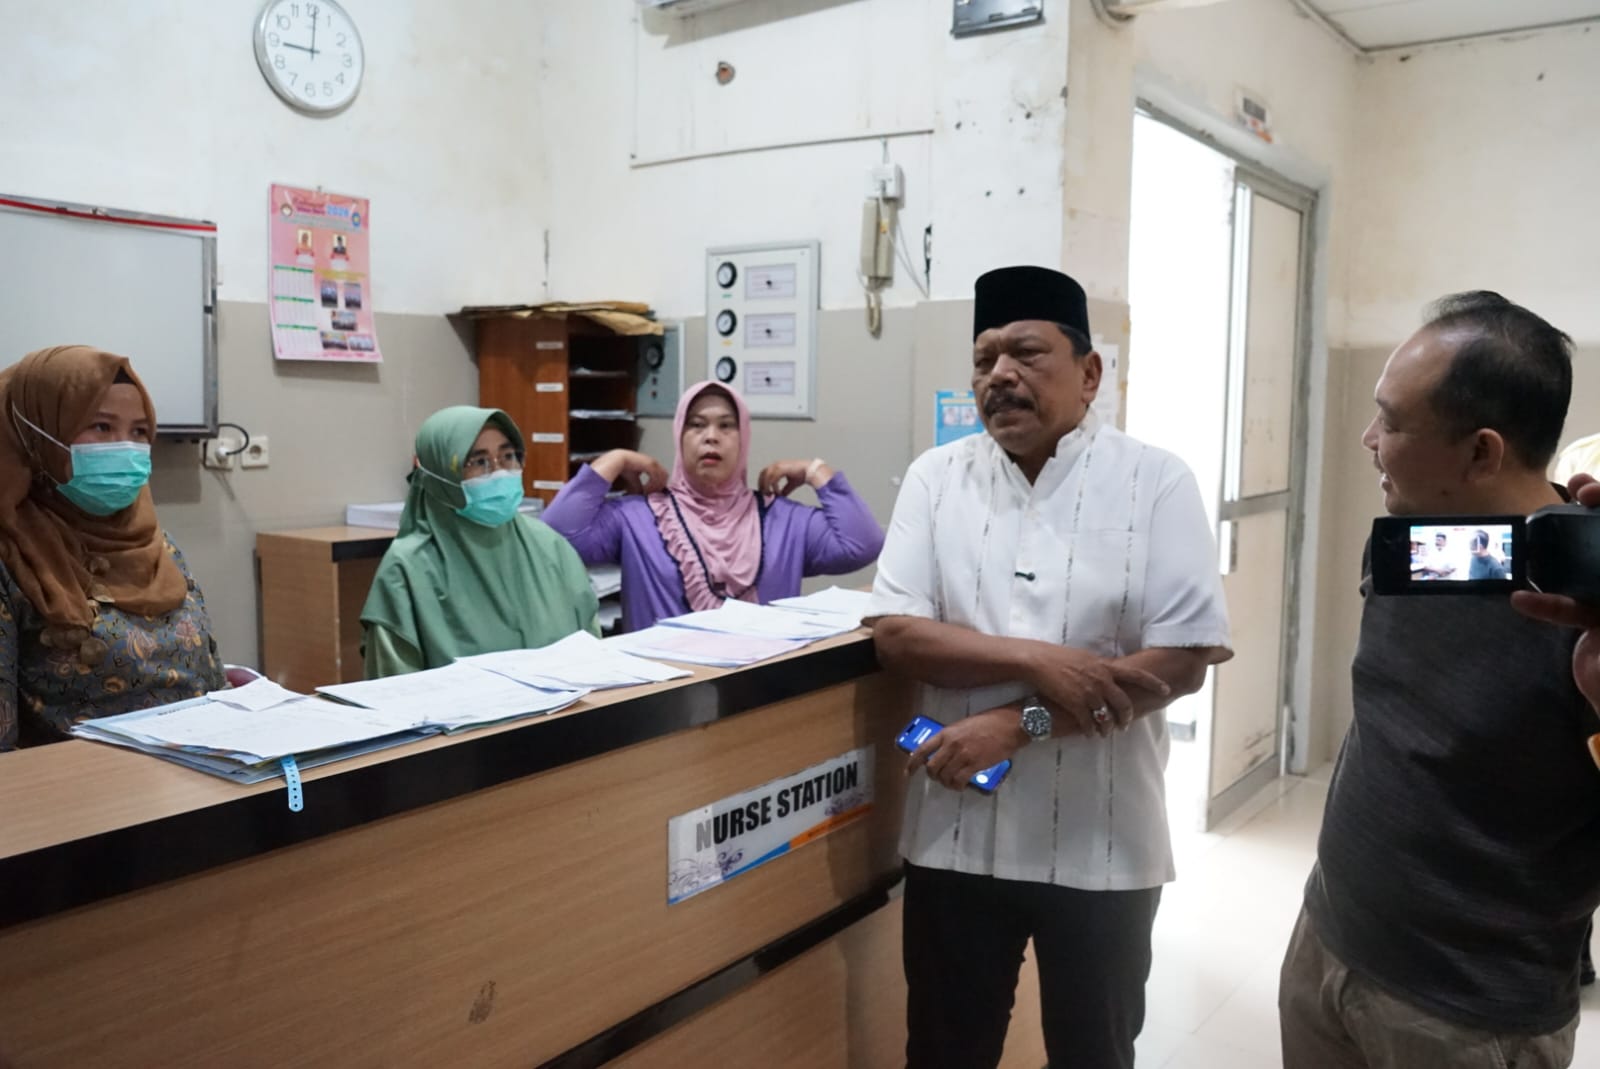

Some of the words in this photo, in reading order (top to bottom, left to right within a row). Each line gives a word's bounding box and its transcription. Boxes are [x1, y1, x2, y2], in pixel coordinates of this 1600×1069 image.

[290, 3, 299, 18] 11
[276, 14, 291, 30] 10
[268, 31, 280, 48] 9
[336, 31, 346, 48] 2
[274, 54, 286, 70] 8
[343, 53, 353, 68] 3
[288, 71, 298, 87] 7
[335, 71, 344, 85] 4
[304, 82, 316, 98] 6
[322, 81, 333, 97] 5
[695, 796, 772, 853] NURSE
[777, 761, 858, 819] STATION
